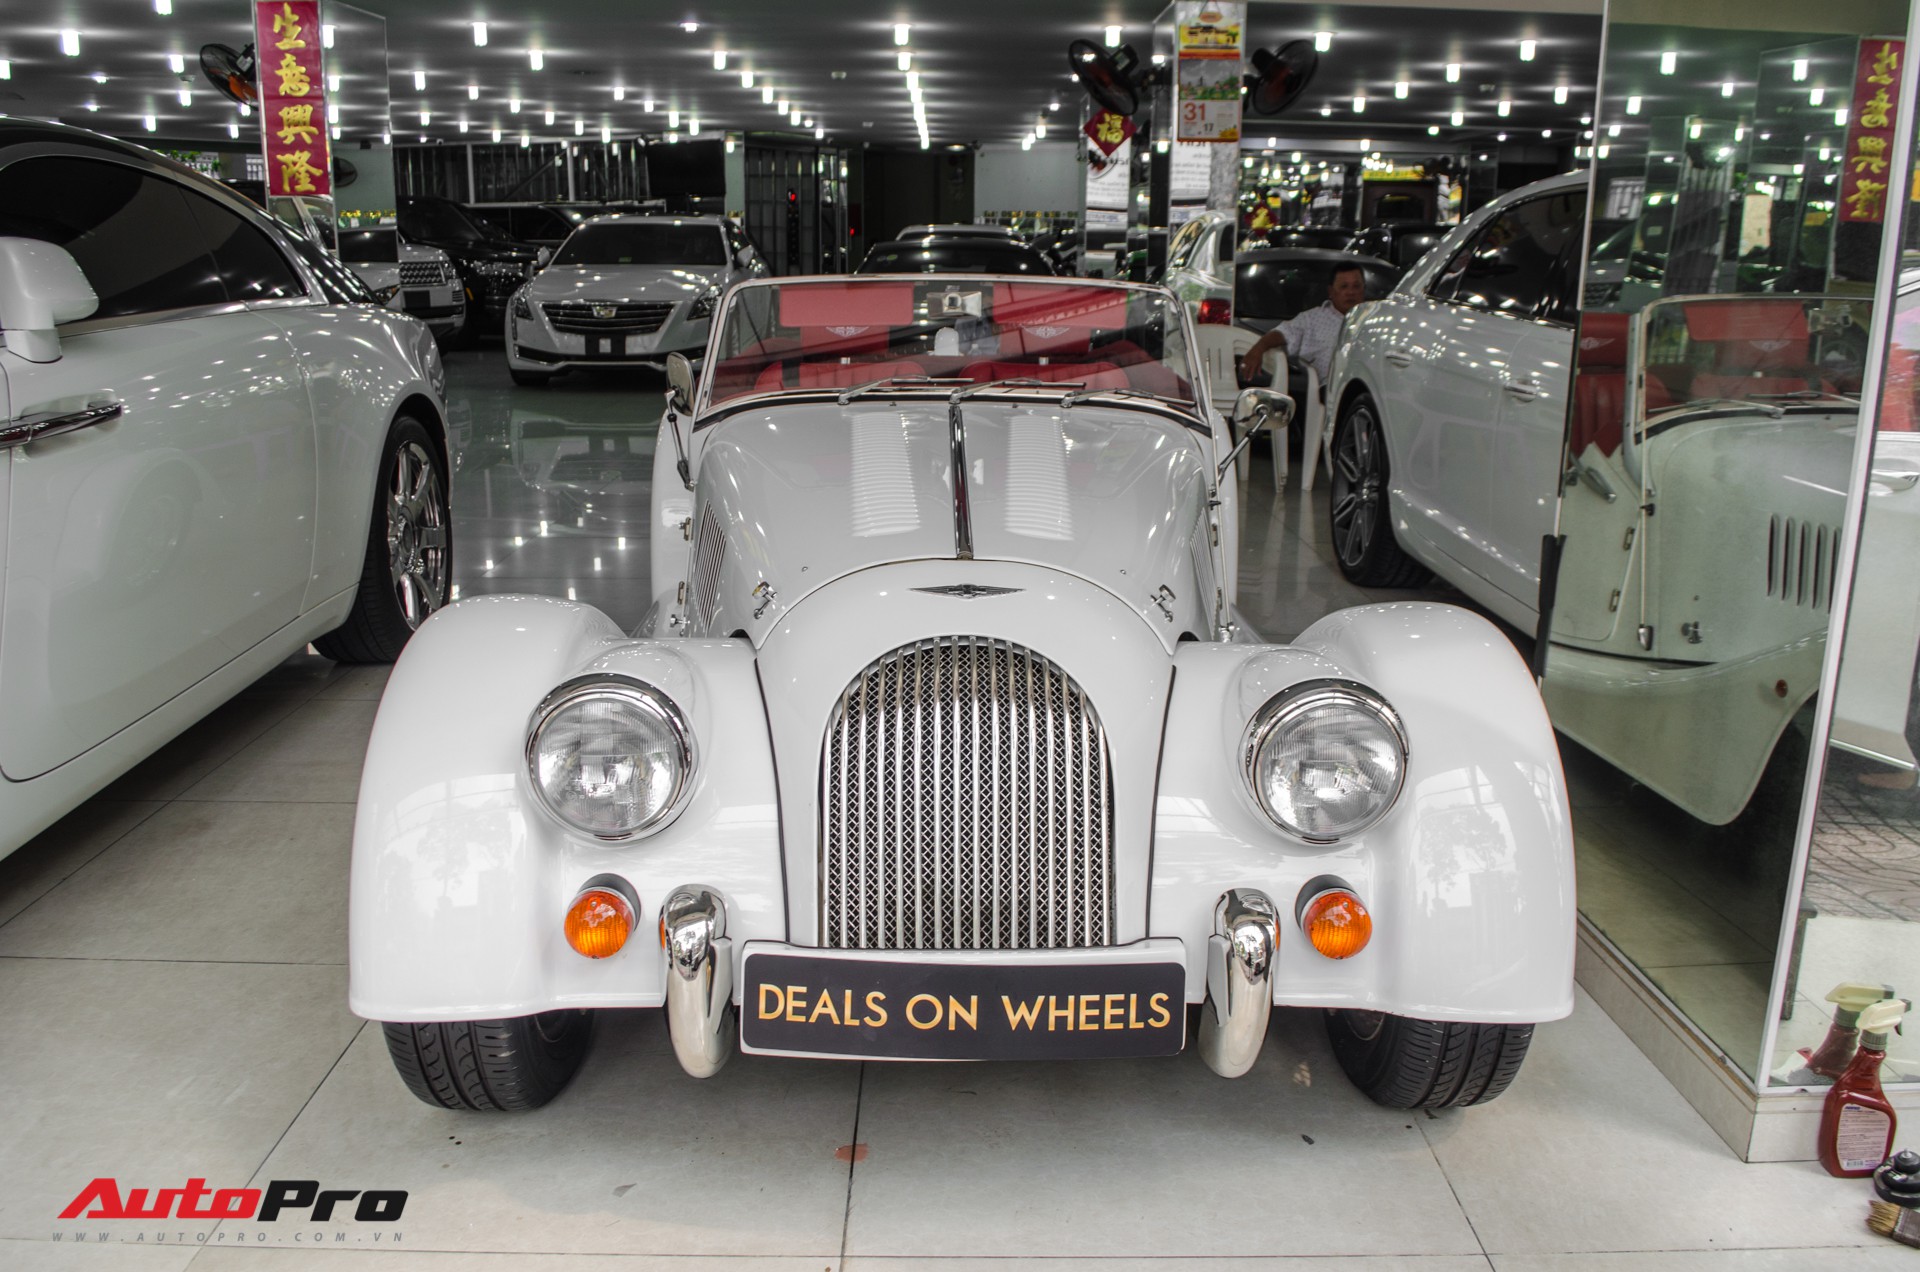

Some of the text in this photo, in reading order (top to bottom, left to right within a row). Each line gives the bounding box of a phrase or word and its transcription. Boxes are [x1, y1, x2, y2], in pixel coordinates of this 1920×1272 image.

[273, 2, 323, 192] 生意興隆
[1184, 102, 1206, 121] 31
[758, 984, 1171, 1031] DEALS ON WHEELS
